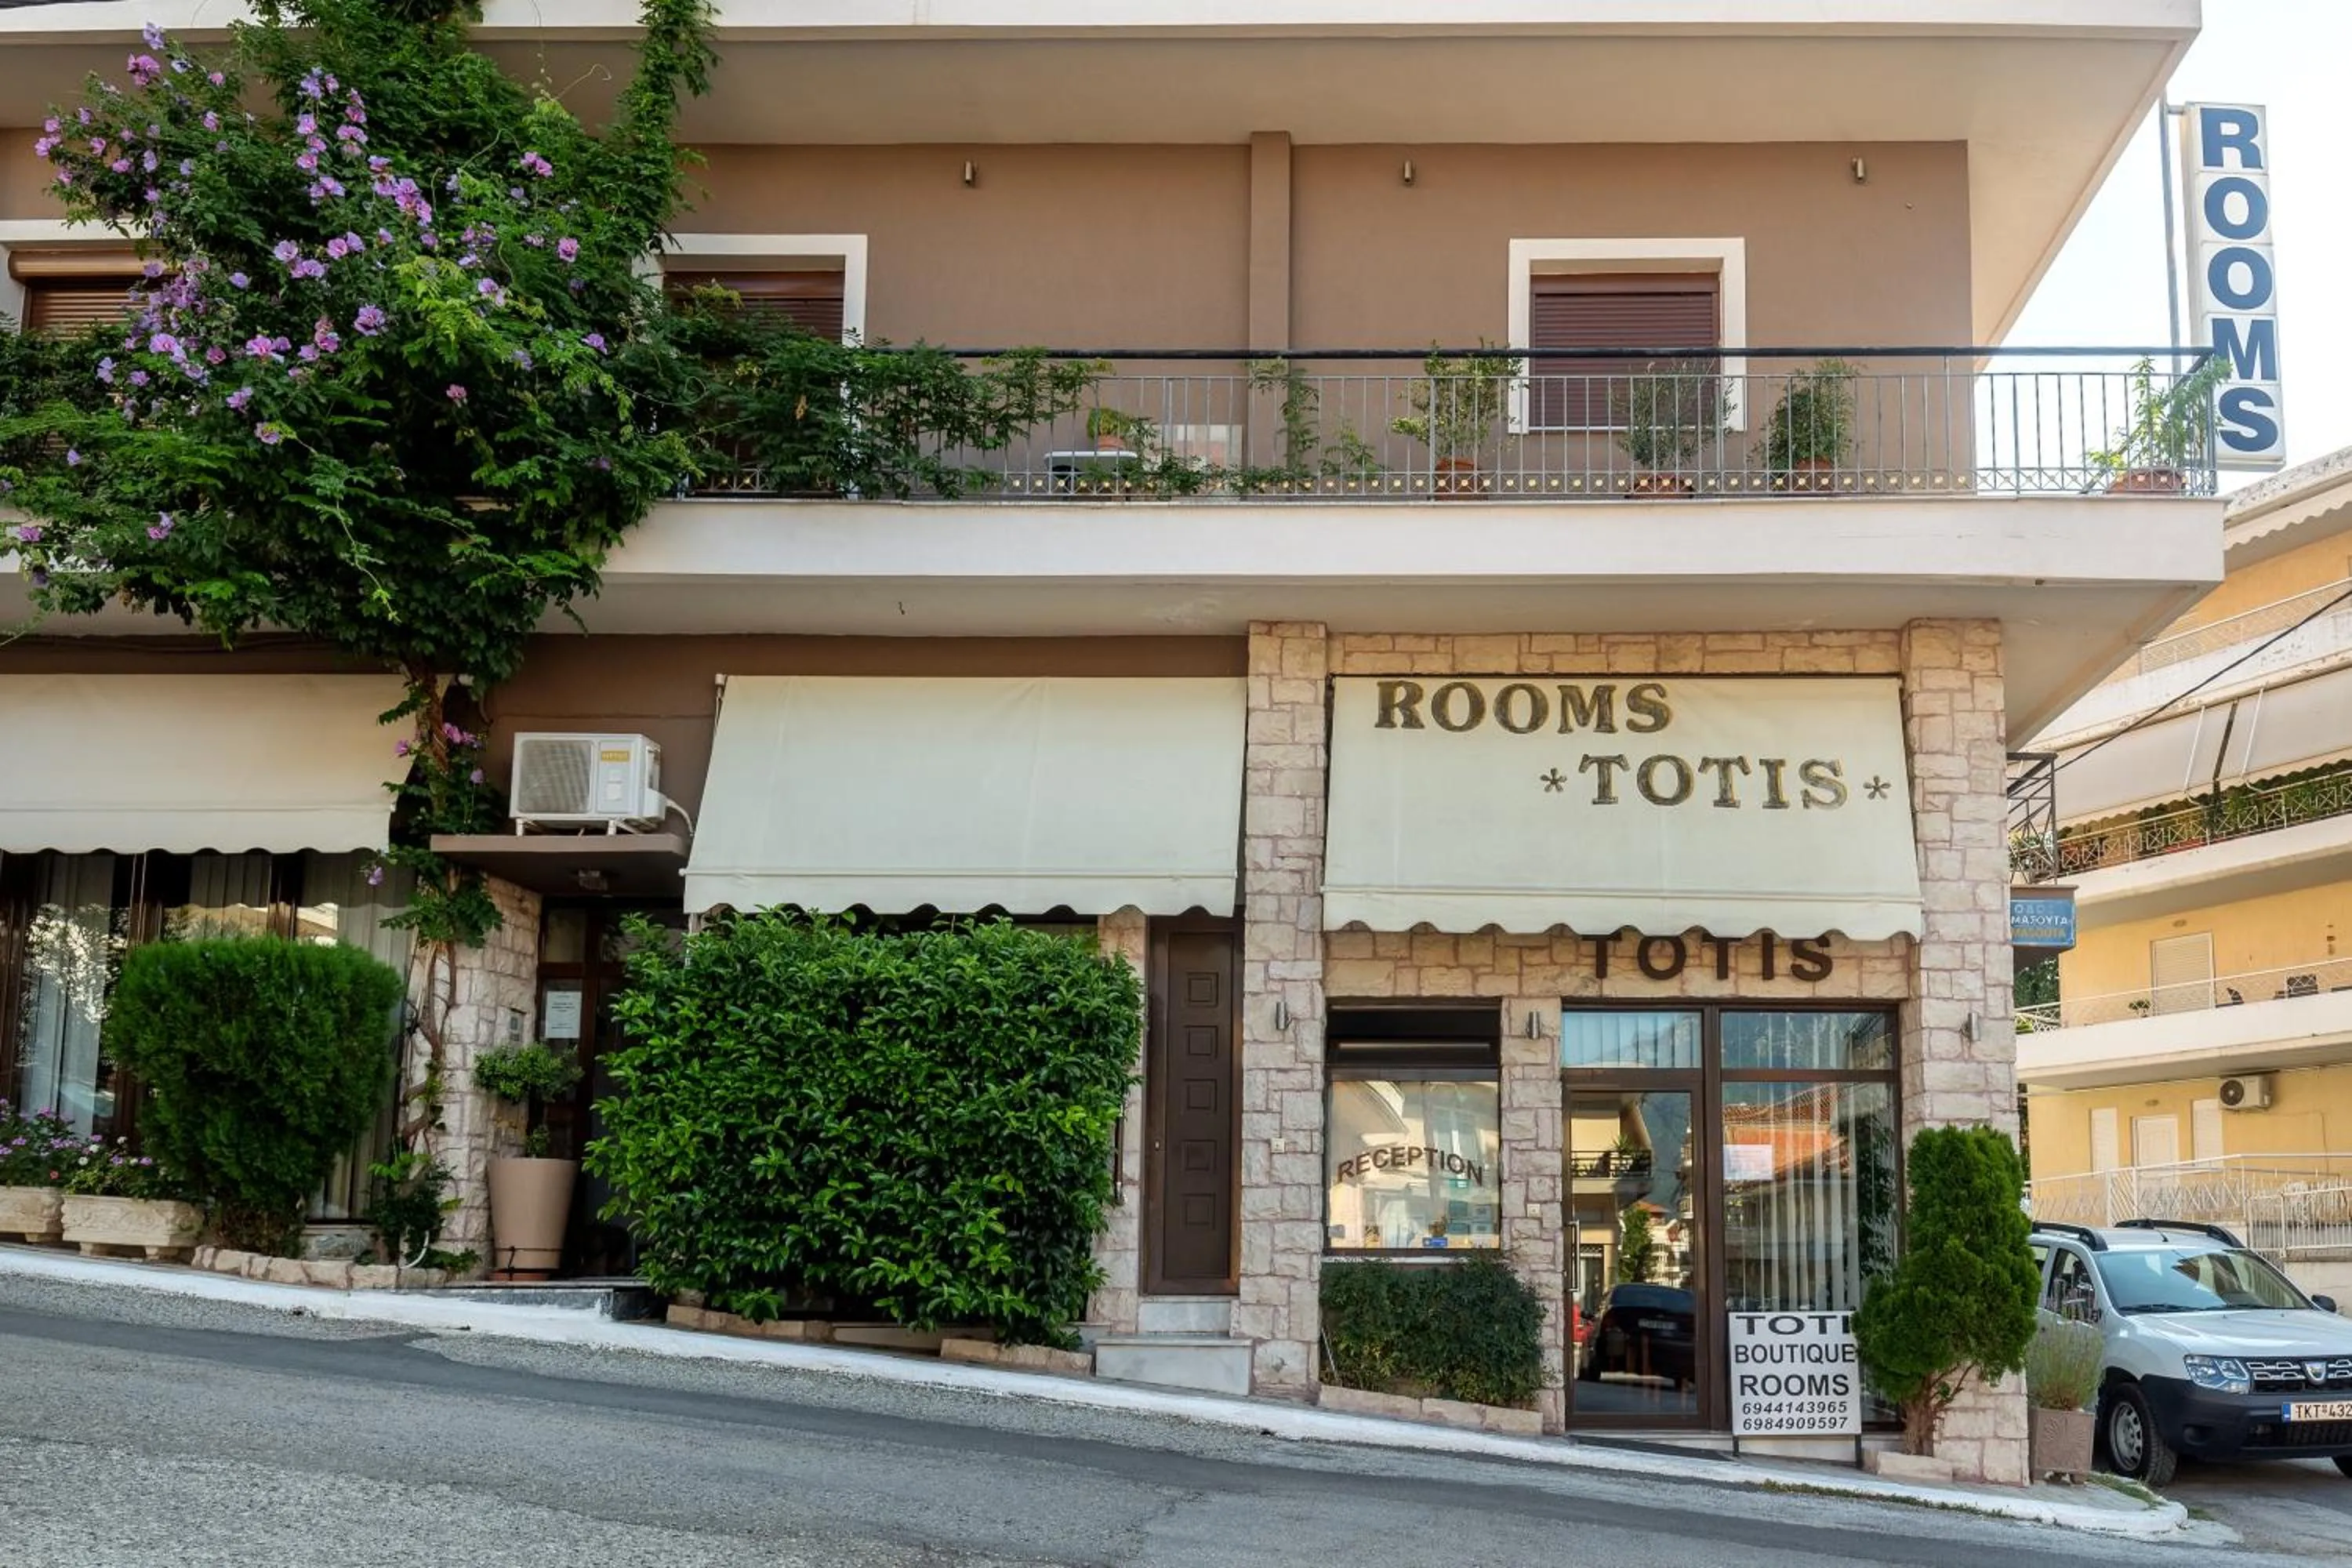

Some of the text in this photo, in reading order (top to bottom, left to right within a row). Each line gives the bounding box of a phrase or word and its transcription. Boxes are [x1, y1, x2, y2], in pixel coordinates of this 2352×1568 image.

[2200, 107, 2278, 452] ROOMS
[1374, 680, 1671, 734] ROOMS
[1581, 931, 1832, 982] TOTIS
[1336, 1146, 1483, 1187] RECEPTION
[1734, 1343, 1857, 1364] BOUTIQUE
[1739, 1374, 1849, 1396] ROOMS
[1742, 1401, 1848, 1414] 6944143965
[1742, 1416, 1849, 1431] 6984909597
